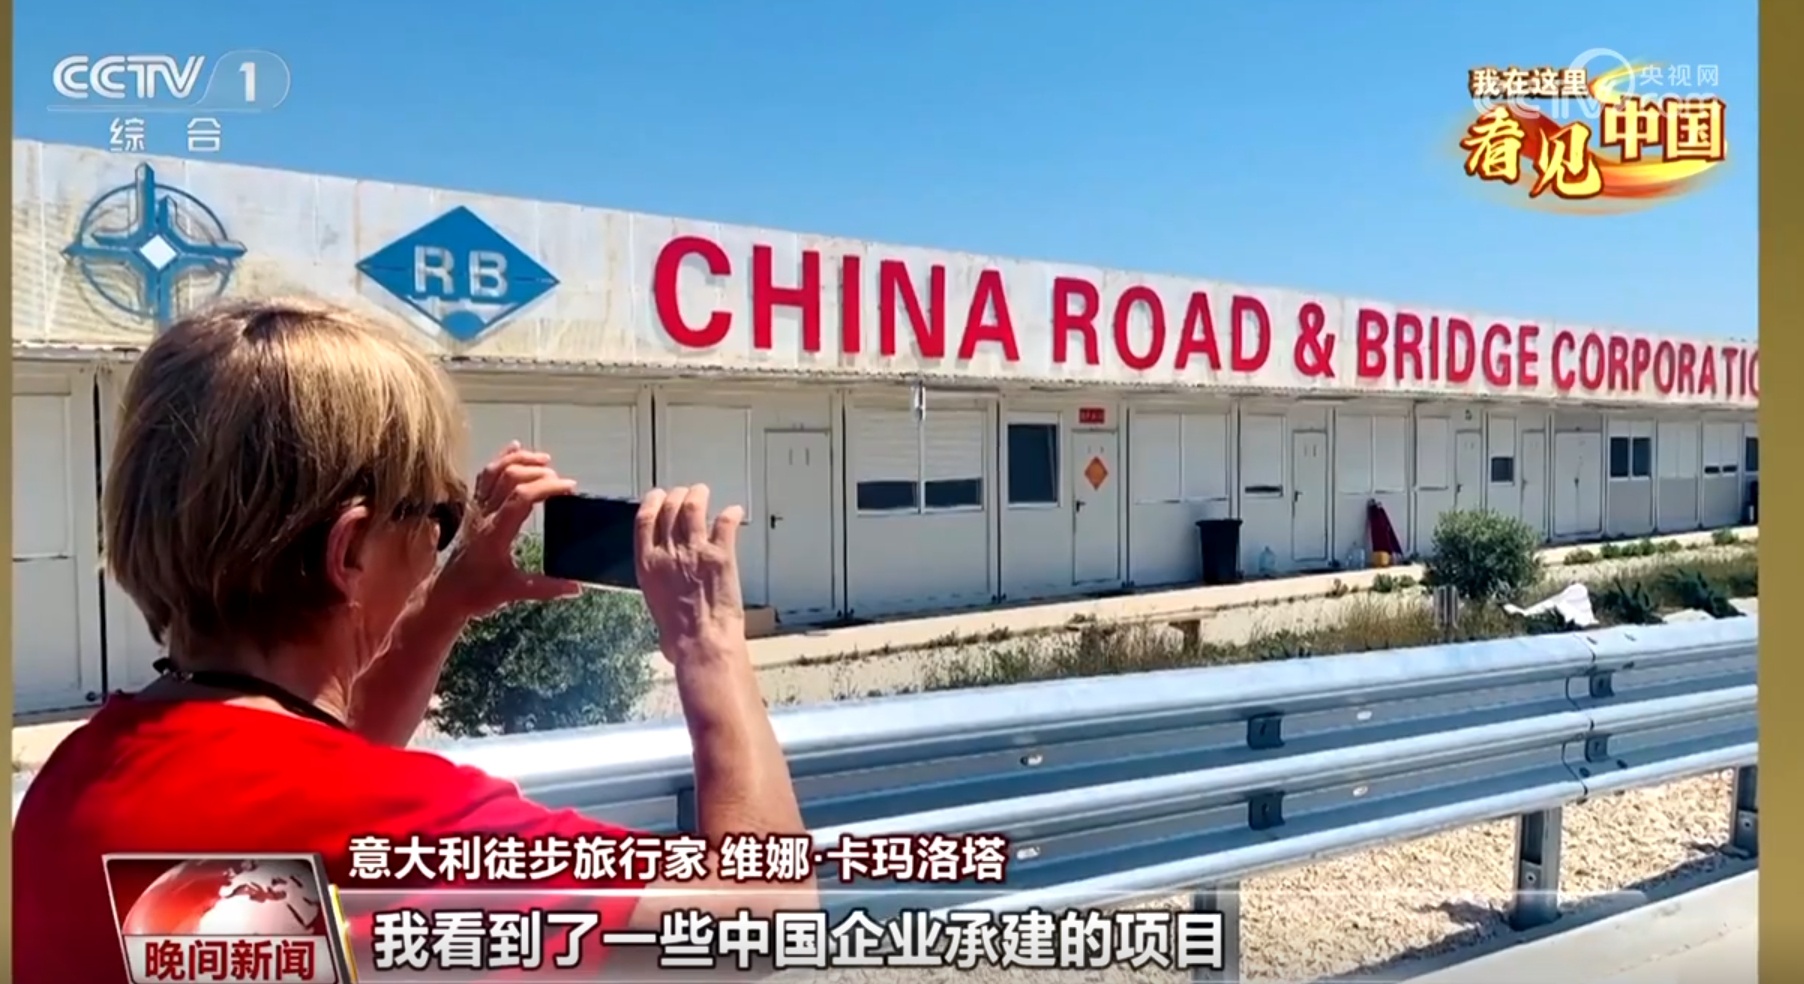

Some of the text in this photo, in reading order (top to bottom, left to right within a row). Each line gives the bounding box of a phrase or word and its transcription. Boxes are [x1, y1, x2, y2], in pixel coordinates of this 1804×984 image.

[413, 245, 508, 297] RB
[653, 236, 1020, 362] CHINA
[1053, 276, 1270, 371] ROAD
[1294, 303, 1335, 377] &
[1357, 308, 1539, 387] BRIDGE
